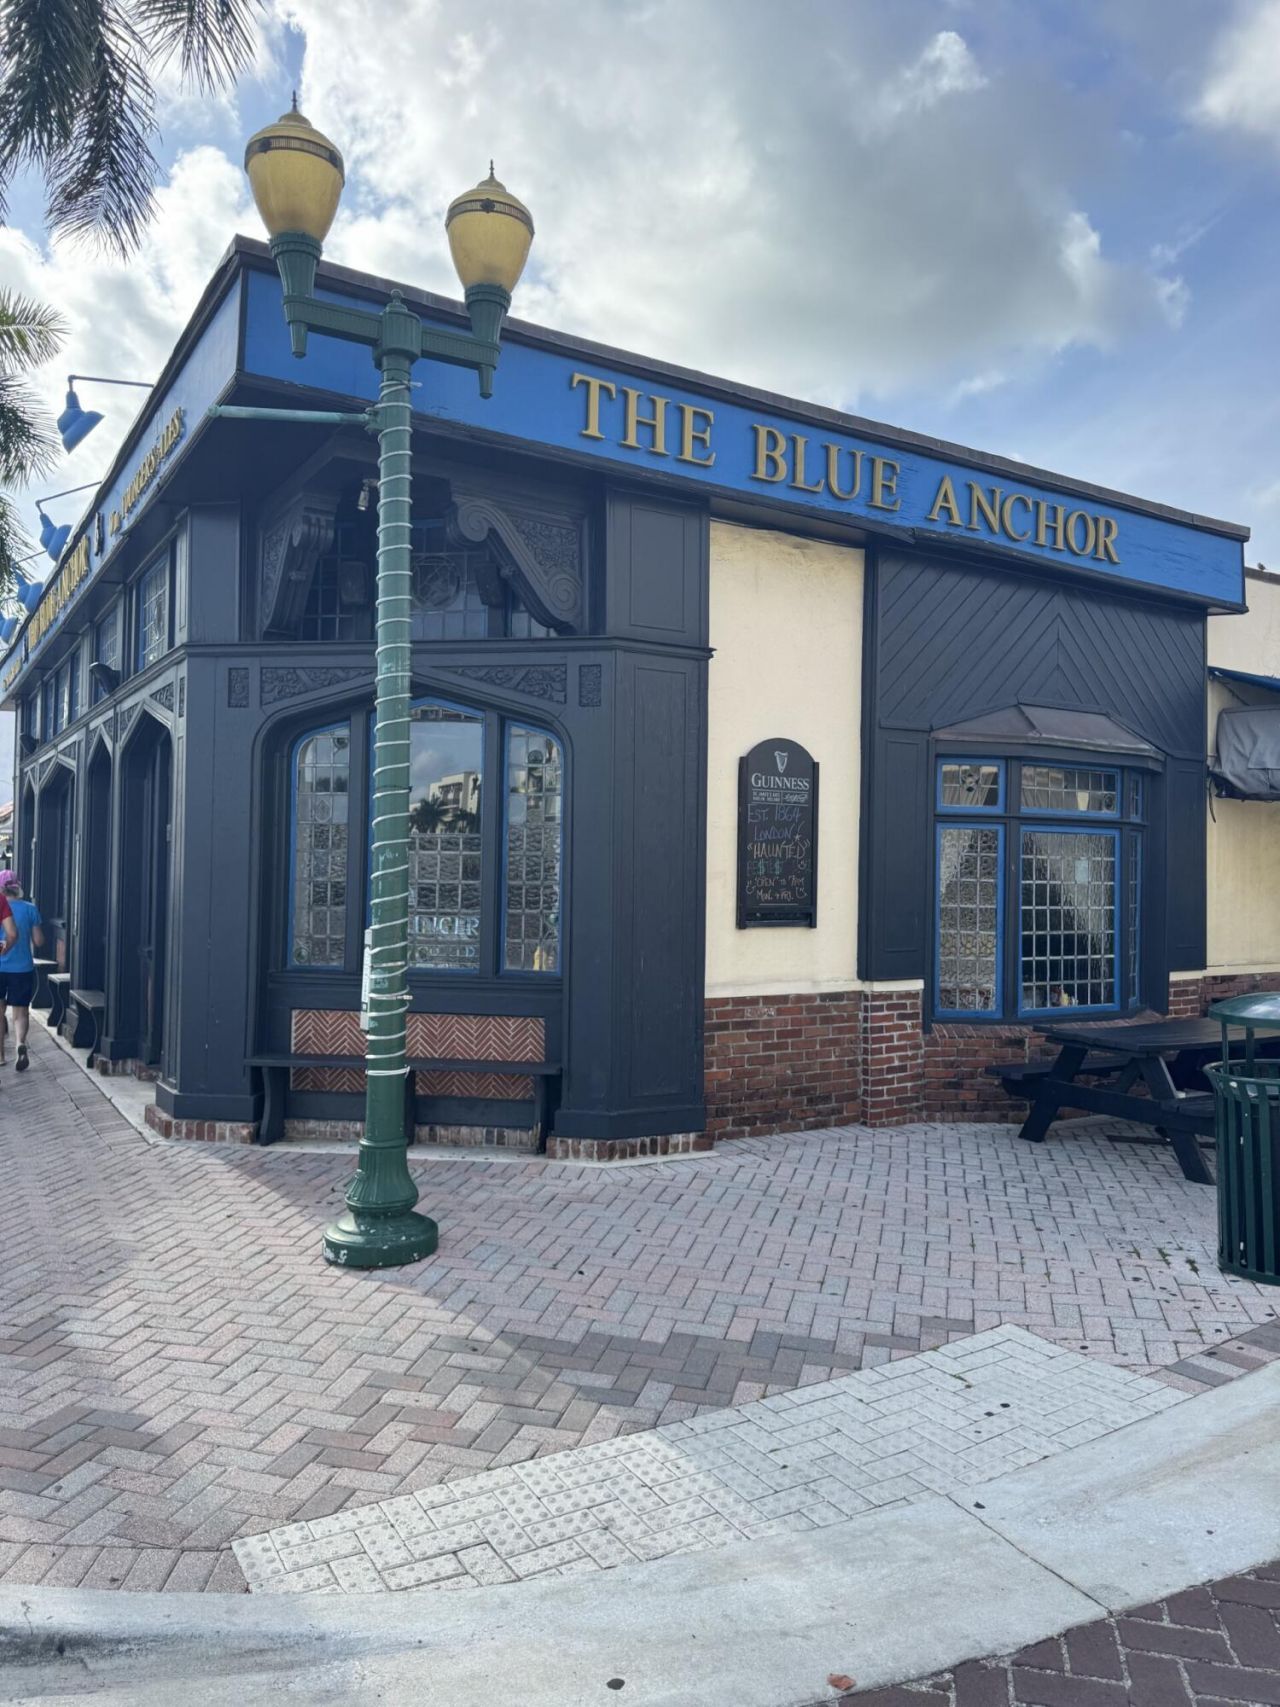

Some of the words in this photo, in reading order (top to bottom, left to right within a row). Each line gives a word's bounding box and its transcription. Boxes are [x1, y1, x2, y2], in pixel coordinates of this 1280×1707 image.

[571, 372, 716, 467] THE
[752, 424, 902, 511] BLUE
[928, 475, 1120, 563] ANCHOR
[751, 772, 810, 791] GUINNESS
